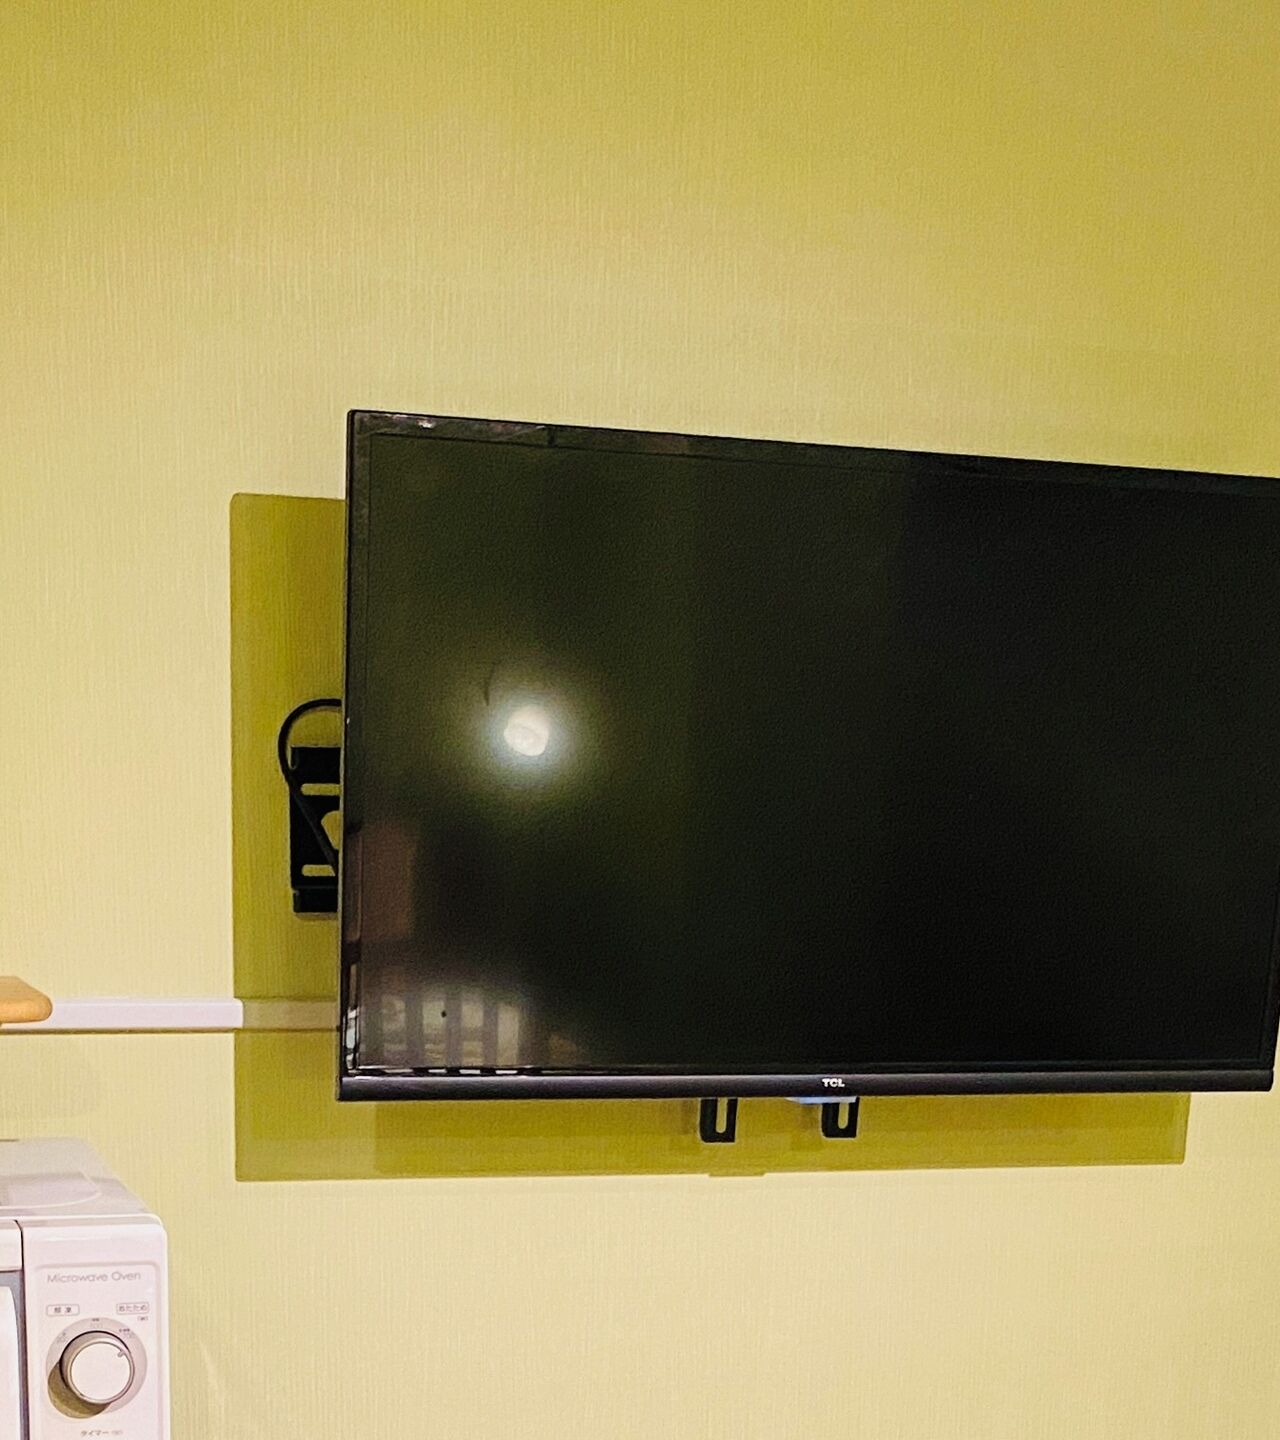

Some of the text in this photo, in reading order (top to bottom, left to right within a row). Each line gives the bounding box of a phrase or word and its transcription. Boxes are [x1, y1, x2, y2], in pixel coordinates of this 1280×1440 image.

[822, 1078, 845, 1087] TCL
[47, 1271, 142, 1283] Microwave Oven
